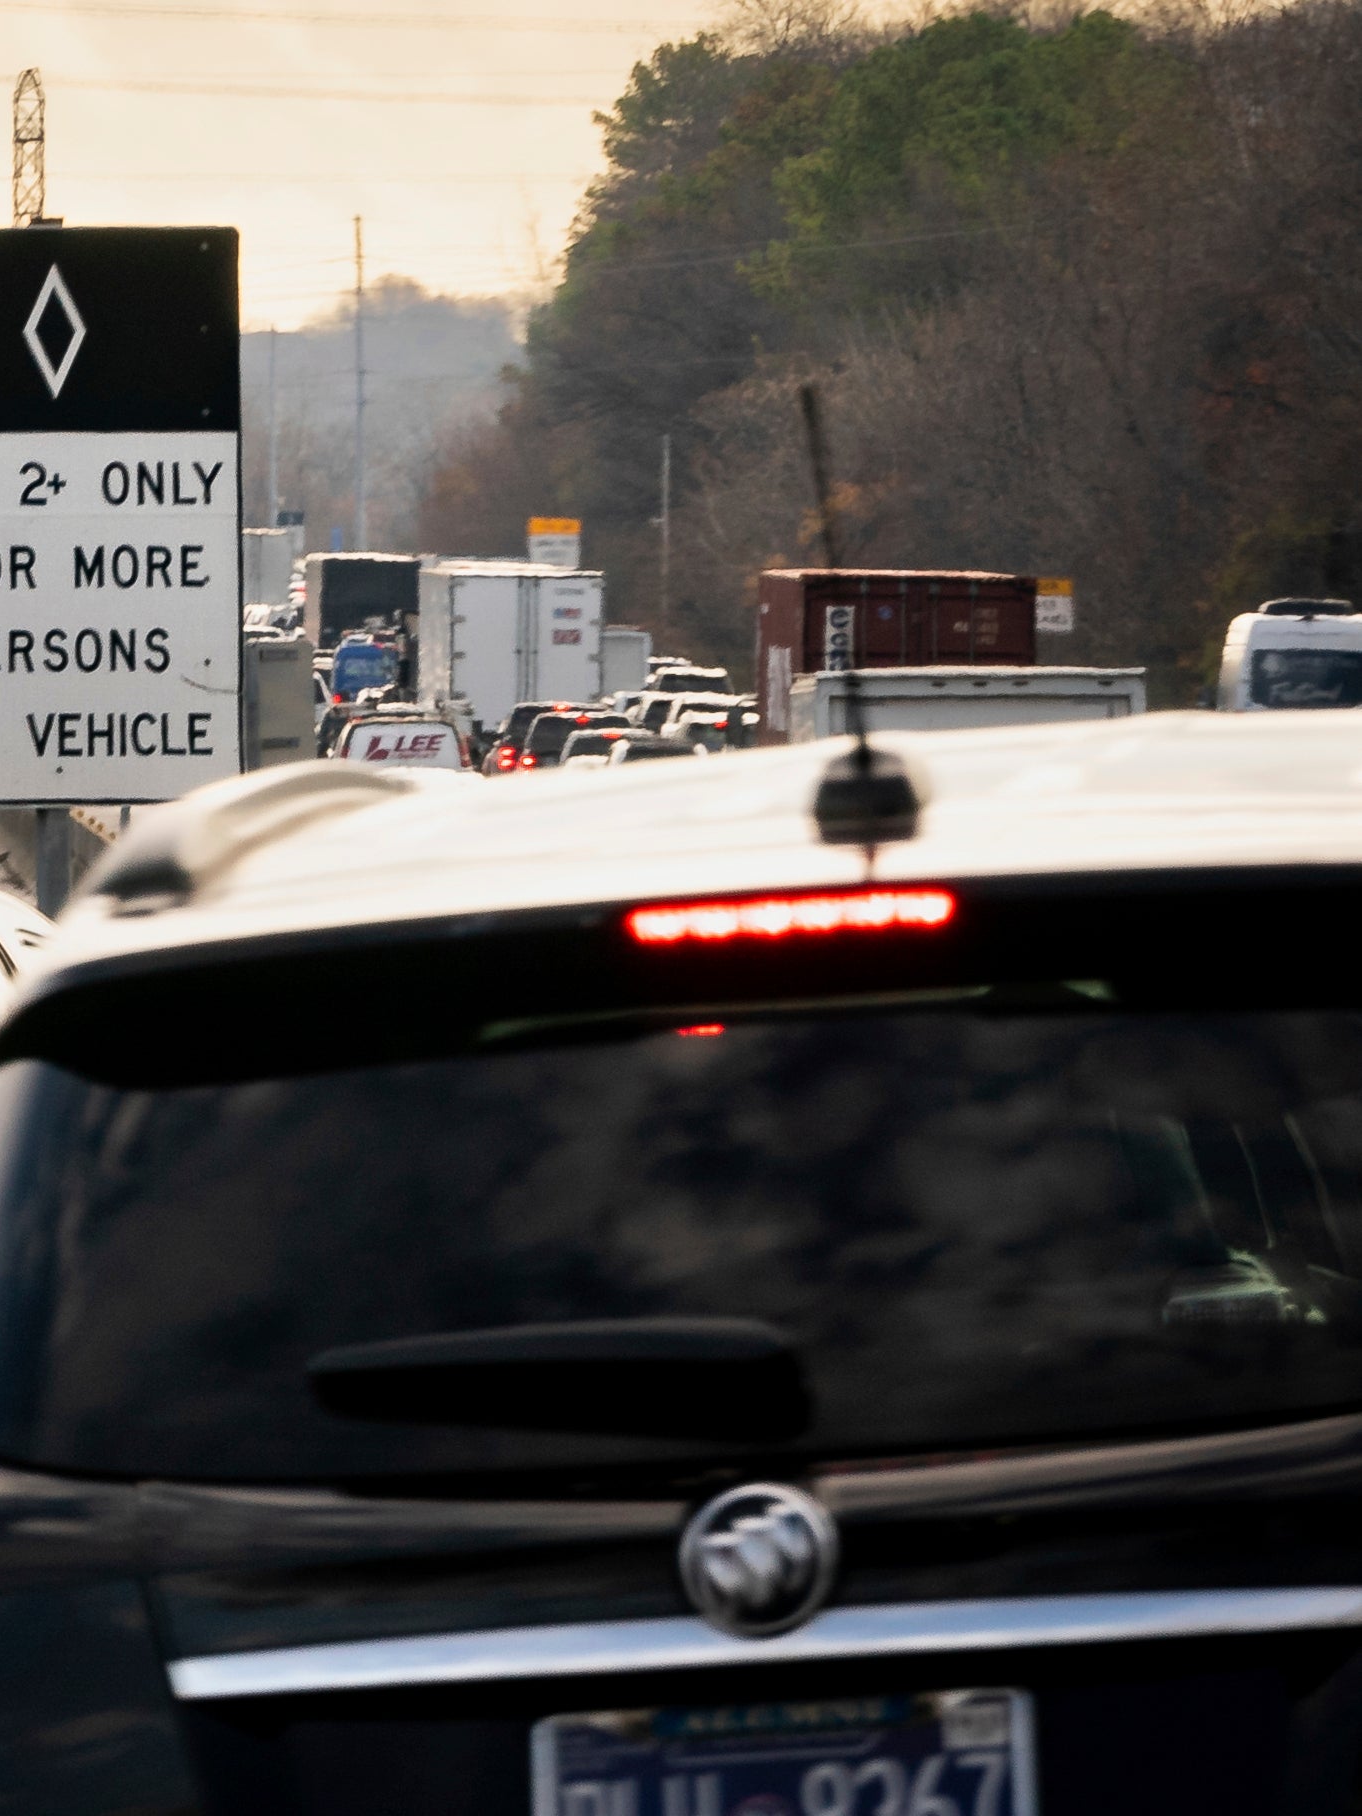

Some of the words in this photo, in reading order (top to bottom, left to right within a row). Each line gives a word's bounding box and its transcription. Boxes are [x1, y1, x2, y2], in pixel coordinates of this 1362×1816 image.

[20, 462, 66, 506] 2+
[102, 462, 222, 506] ONLY
[74, 545, 209, 588] MORE
[26, 713, 212, 757] VEHICLE
[394, 733, 446, 752] LEE
